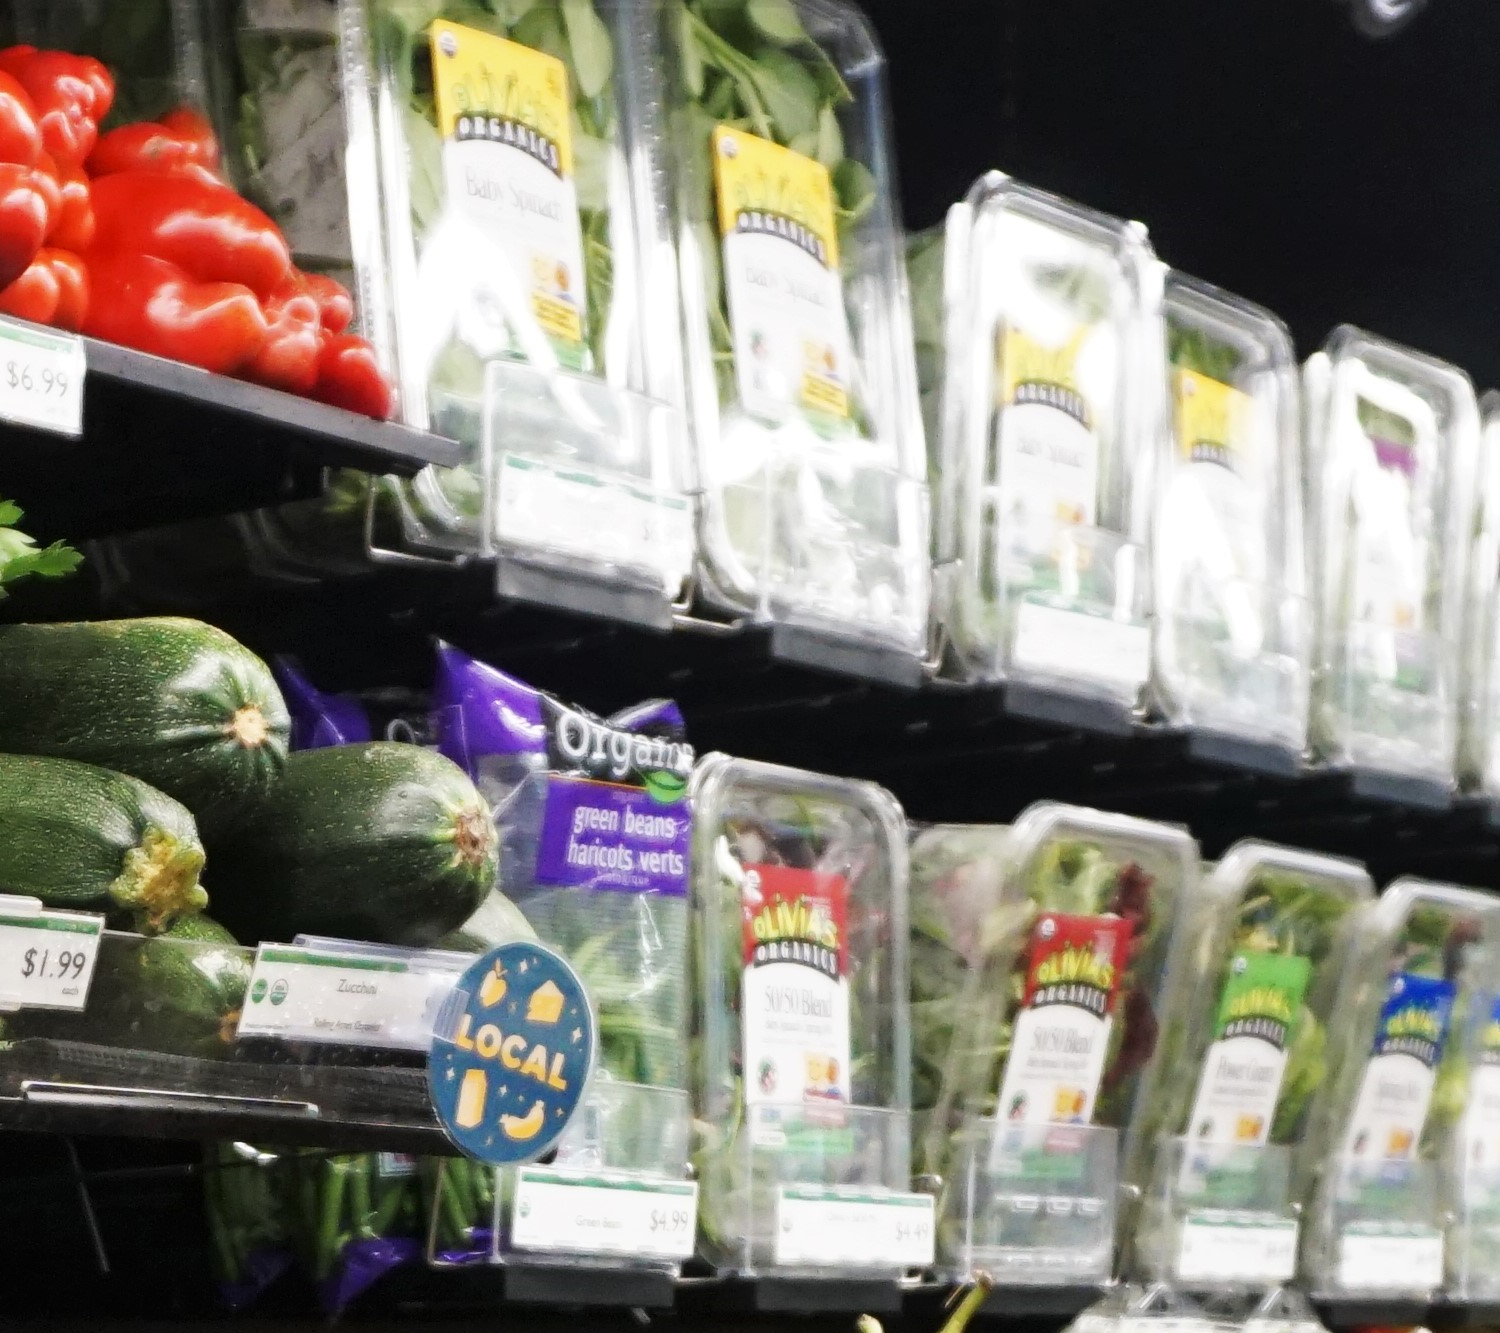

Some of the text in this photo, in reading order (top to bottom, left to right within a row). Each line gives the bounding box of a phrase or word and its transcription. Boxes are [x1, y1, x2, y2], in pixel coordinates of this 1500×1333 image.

[459, 115, 559, 172] ORGANICS
[466, 164, 502, 209] Baby
[738, 210, 827, 264] ORGANICS
[7, 361, 68, 398] $6.99
[574, 804, 675, 839] green beans
[567, 836, 685, 876] haricots verts
[21, 948, 86, 979] $1.99
[754, 942, 839, 977] ORGANICS
[337, 979, 377, 995] Zucchini
[801, 986, 833, 1019] Blend
[1033, 983, 1107, 1016] ORGANICS
[455, 1014, 567, 1093] LOCAL
[576, 1214, 599, 1228] Green
[649, 1209, 688, 1233] $4.99
[896, 1222, 929, 1241] $4.49
